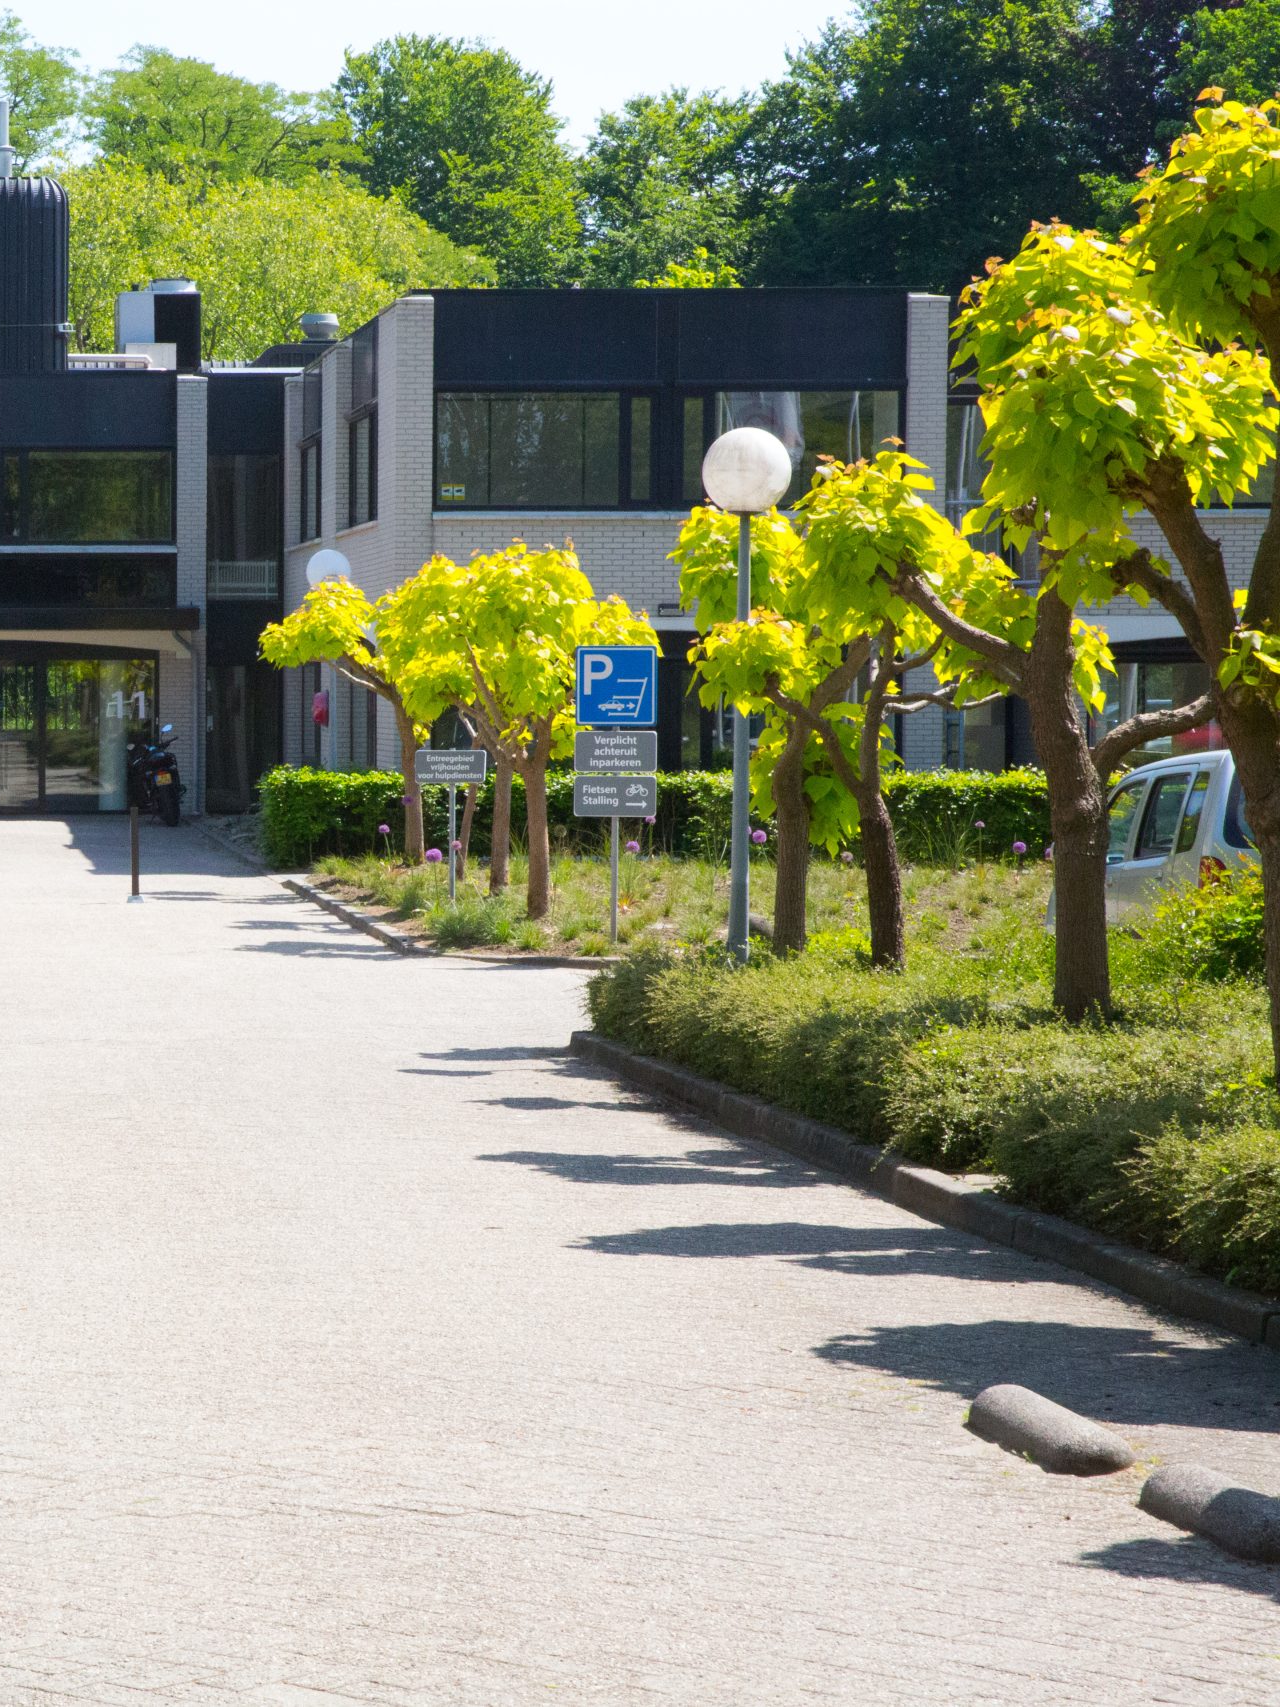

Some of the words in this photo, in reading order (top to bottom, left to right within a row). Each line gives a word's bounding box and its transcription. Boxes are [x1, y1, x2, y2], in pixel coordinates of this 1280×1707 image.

[583, 654, 614, 696] P
[111, 690, 145, 719] 11
[594, 735, 637, 747] Verplicht
[594, 746, 637, 756] achteruit
[426, 755, 475, 764] Entreegebied
[590, 757, 642, 769] inparkeren
[430, 763, 470, 772] vrijhouden
[435, 772, 482, 780] hulpdiensten
[582, 784, 617, 795] Fietsen
[582, 795, 619, 807] Stalling
